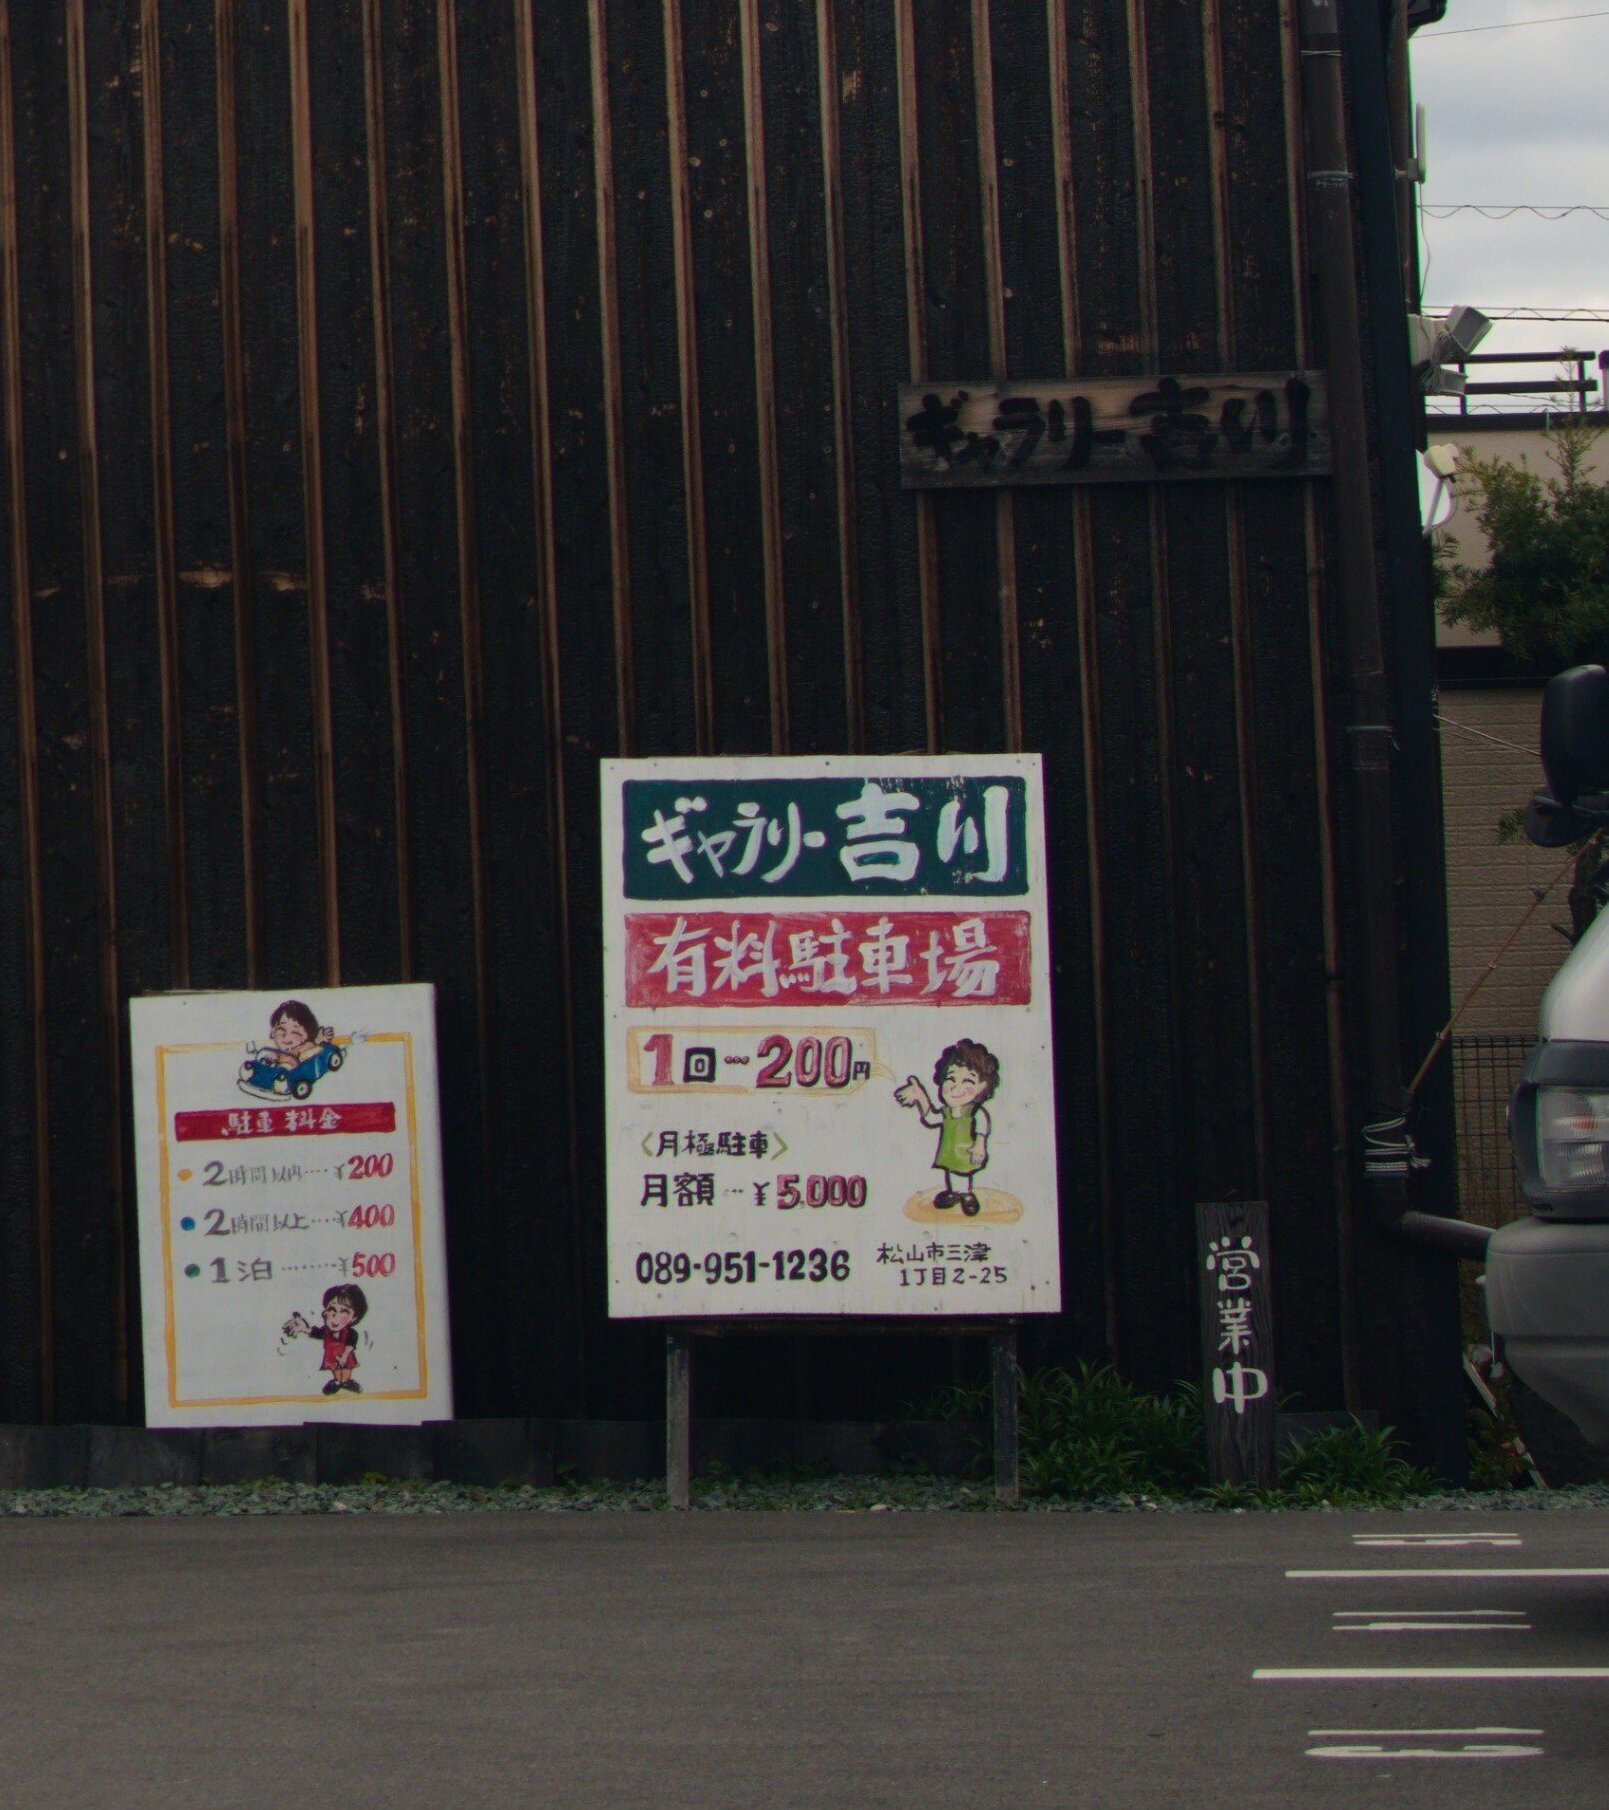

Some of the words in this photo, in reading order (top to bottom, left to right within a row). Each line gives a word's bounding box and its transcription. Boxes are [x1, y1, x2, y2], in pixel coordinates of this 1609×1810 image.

[640, 783, 1008, 885] ギャラリー吉川
[653, 918, 999, 998] 有料駐車場
[636, 1247, 850, 1285] 089-951-1236
[1206, 1235, 1268, 1415] 営業中
